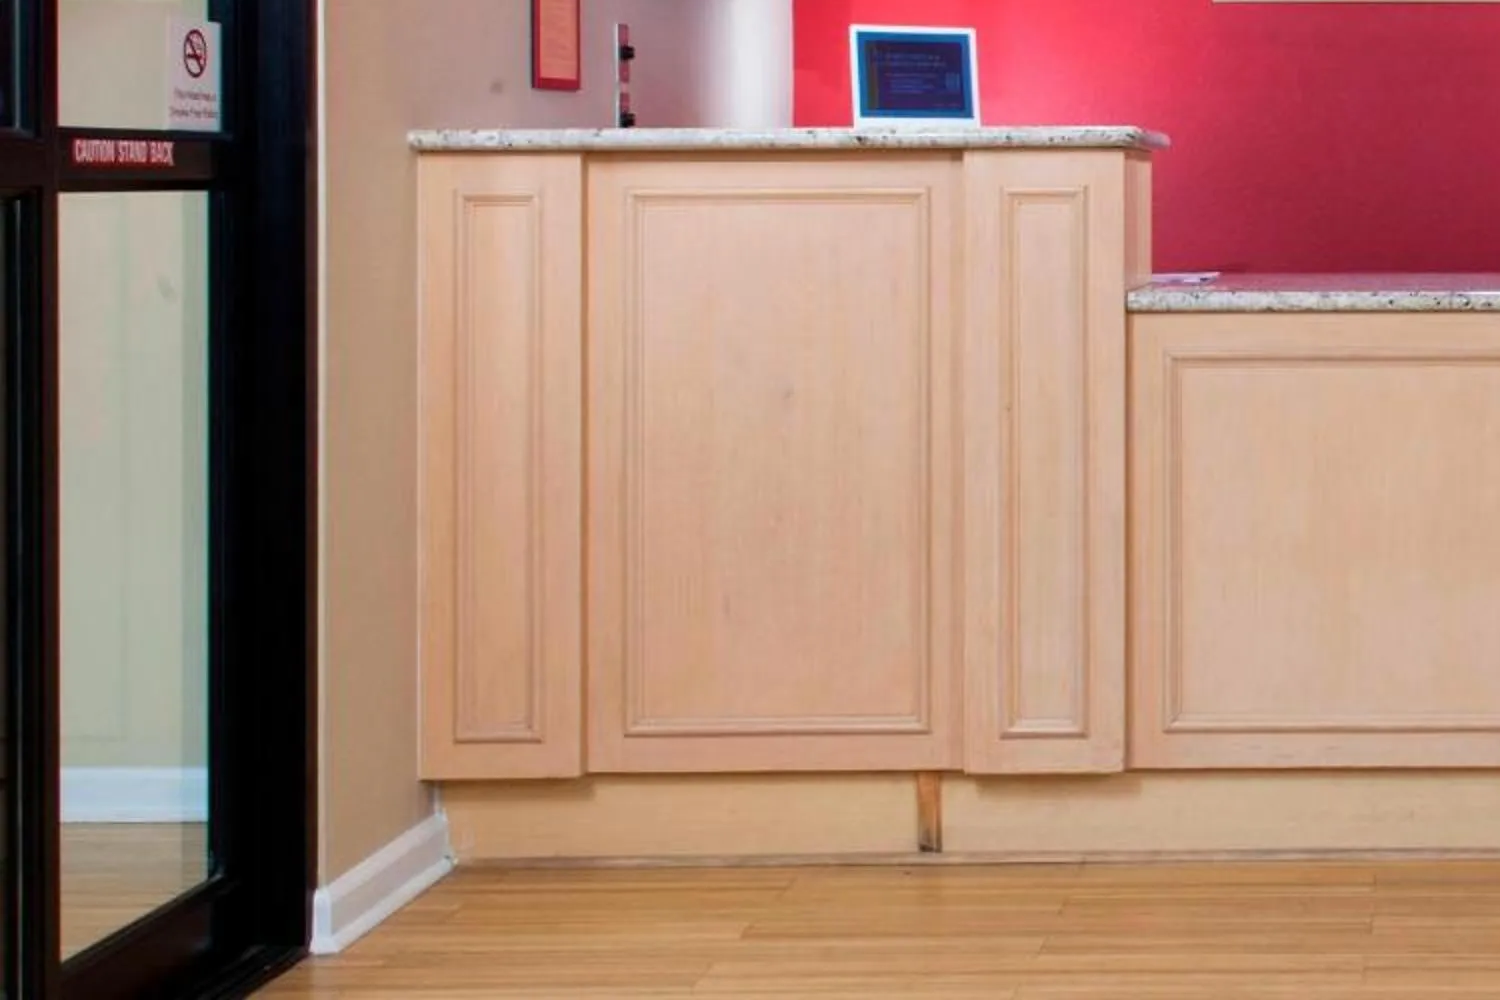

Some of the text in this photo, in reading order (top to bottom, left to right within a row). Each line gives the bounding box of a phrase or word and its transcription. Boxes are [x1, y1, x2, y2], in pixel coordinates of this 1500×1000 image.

[74, 139, 175, 166] CAUTION STAND BACK
